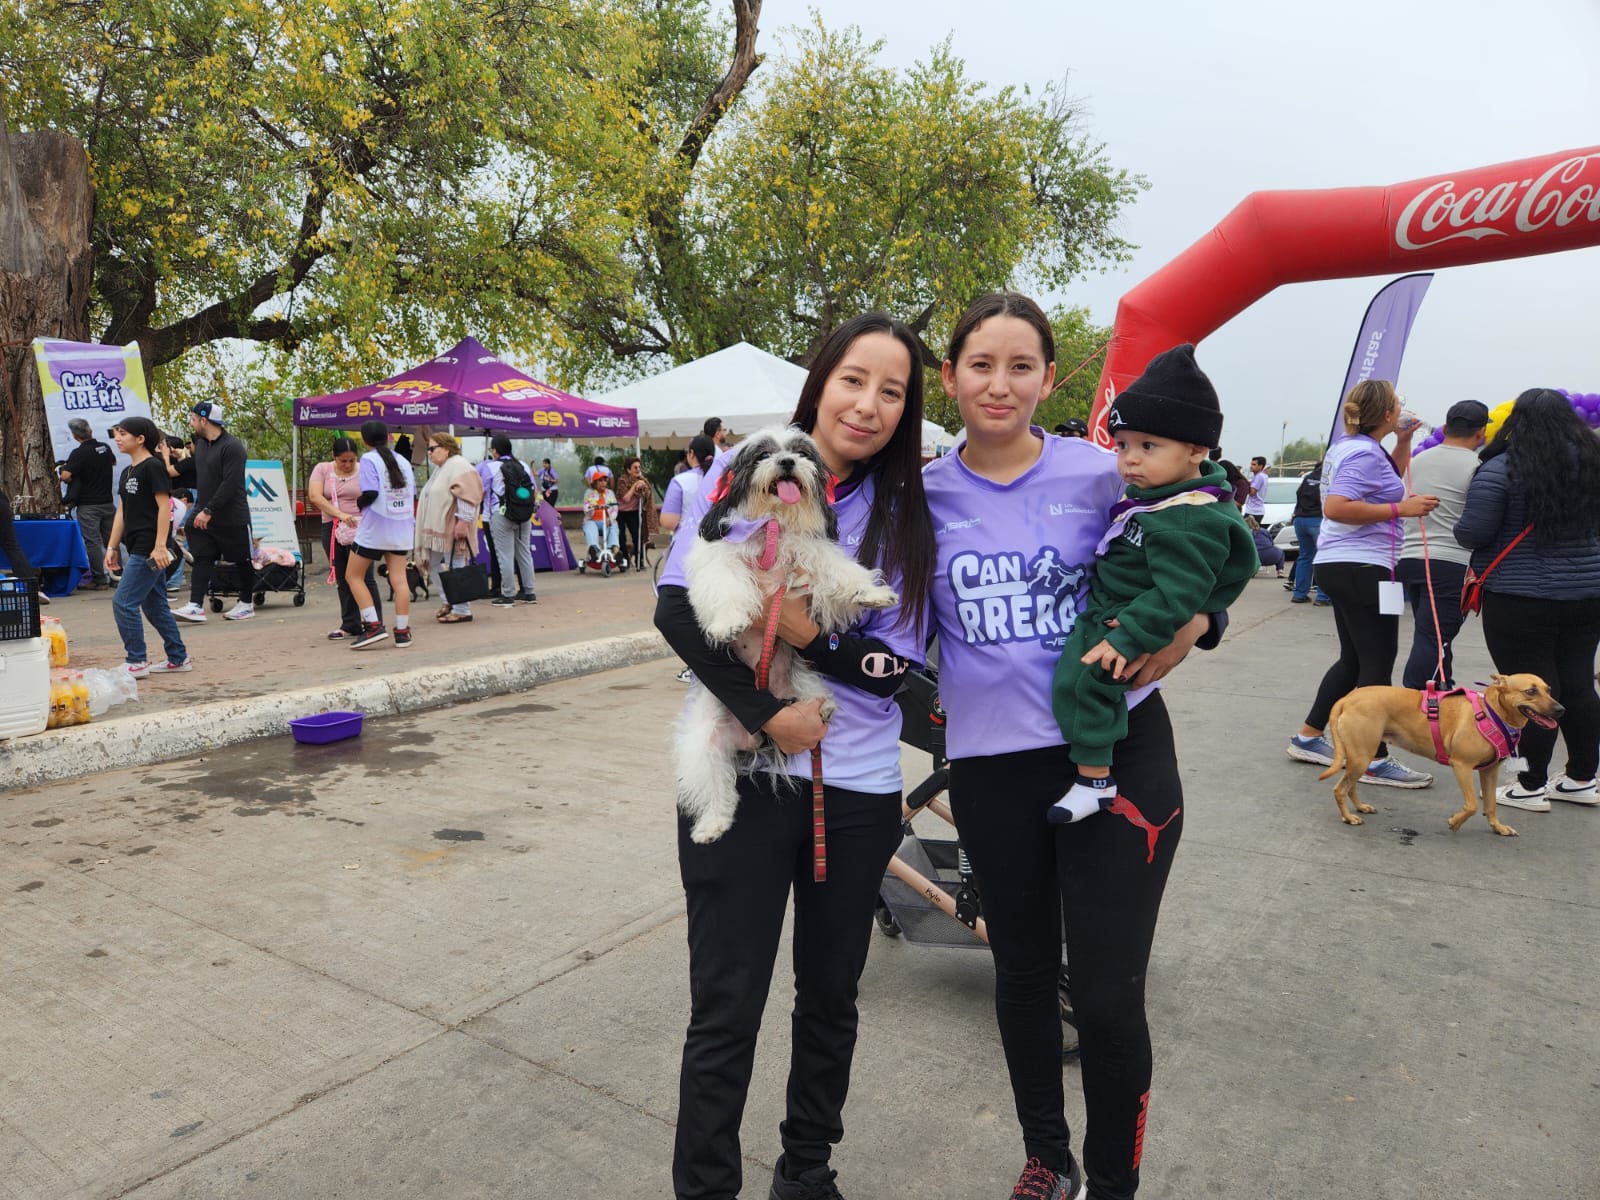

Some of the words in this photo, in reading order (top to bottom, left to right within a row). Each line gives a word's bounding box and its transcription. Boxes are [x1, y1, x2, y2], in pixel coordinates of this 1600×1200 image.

[61, 371, 97, 392] CAN
[65, 389, 122, 410] RRERA
[346, 401, 385, 417] 89.7
[533, 411, 579, 427] 89.7
[951, 553, 1028, 601] CAN
[958, 593, 1079, 644] RRERA
